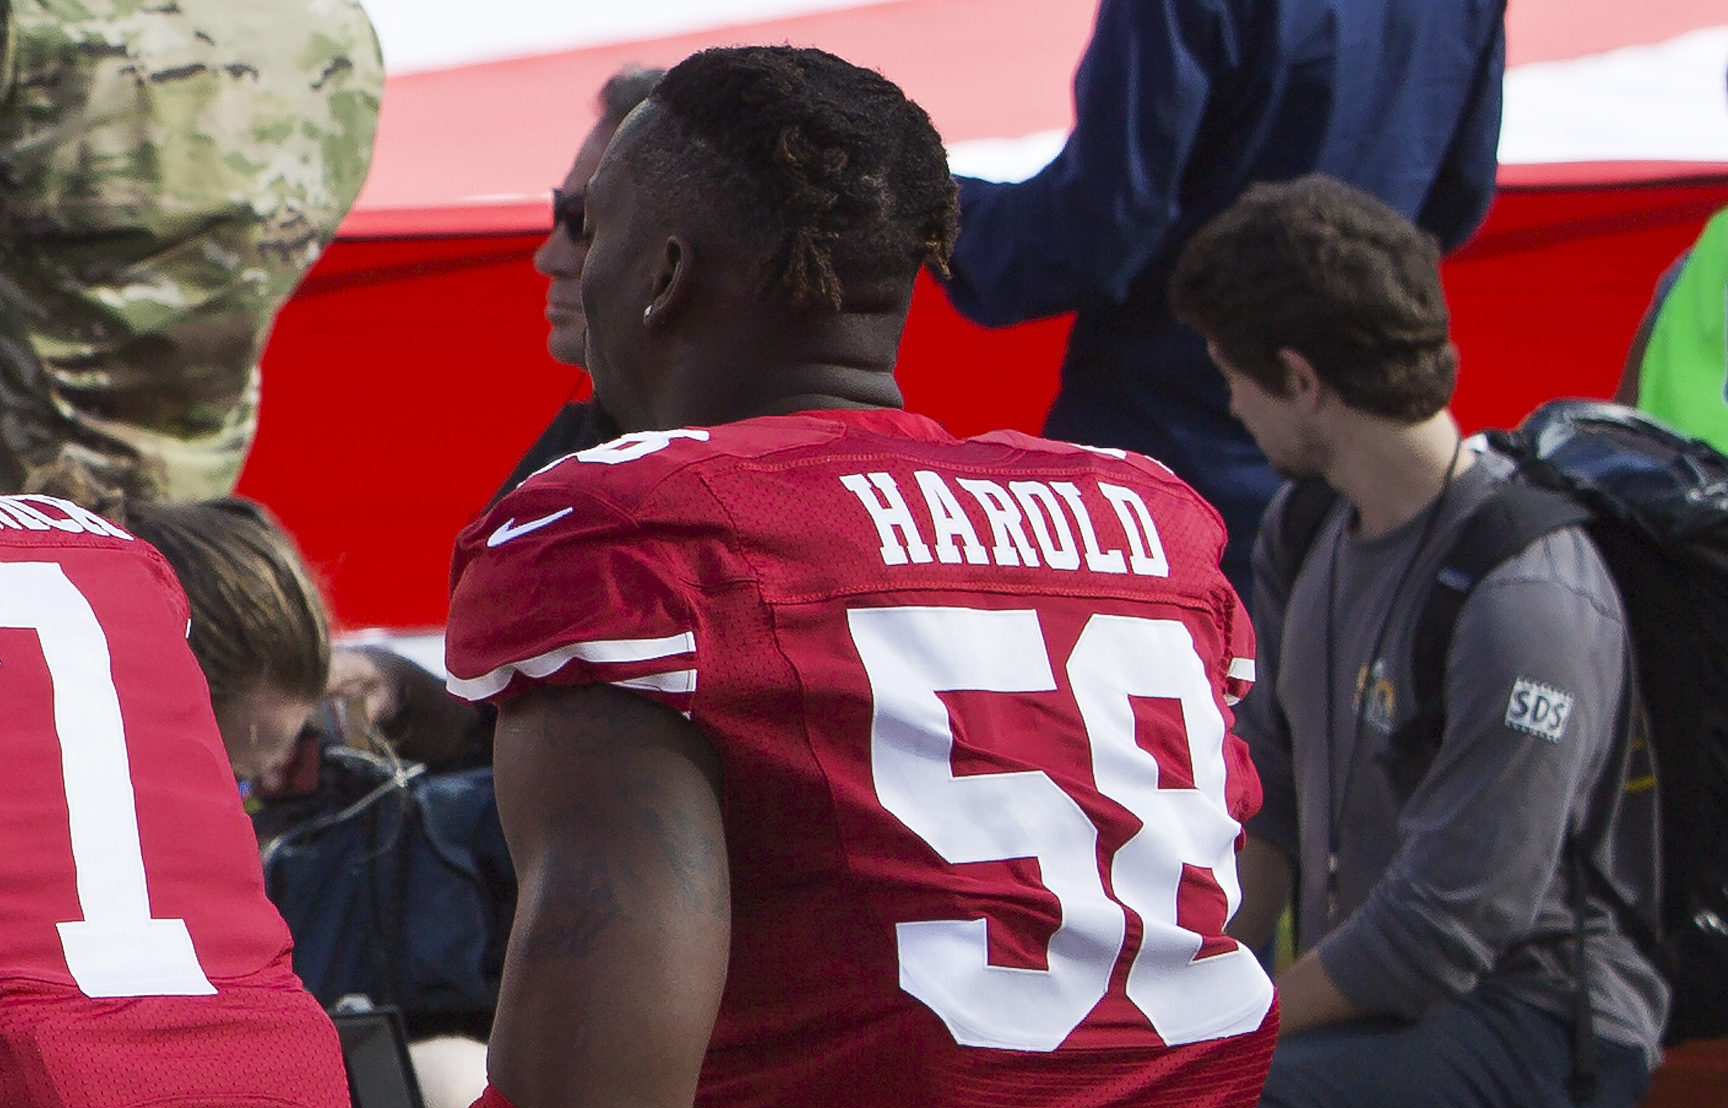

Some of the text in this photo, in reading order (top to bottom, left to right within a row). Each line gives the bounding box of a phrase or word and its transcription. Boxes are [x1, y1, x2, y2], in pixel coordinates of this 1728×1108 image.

[840, 470, 1170, 578] HAROLD
[1511, 690, 1568, 730] SDS
[846, 606, 1275, 1053] 58
